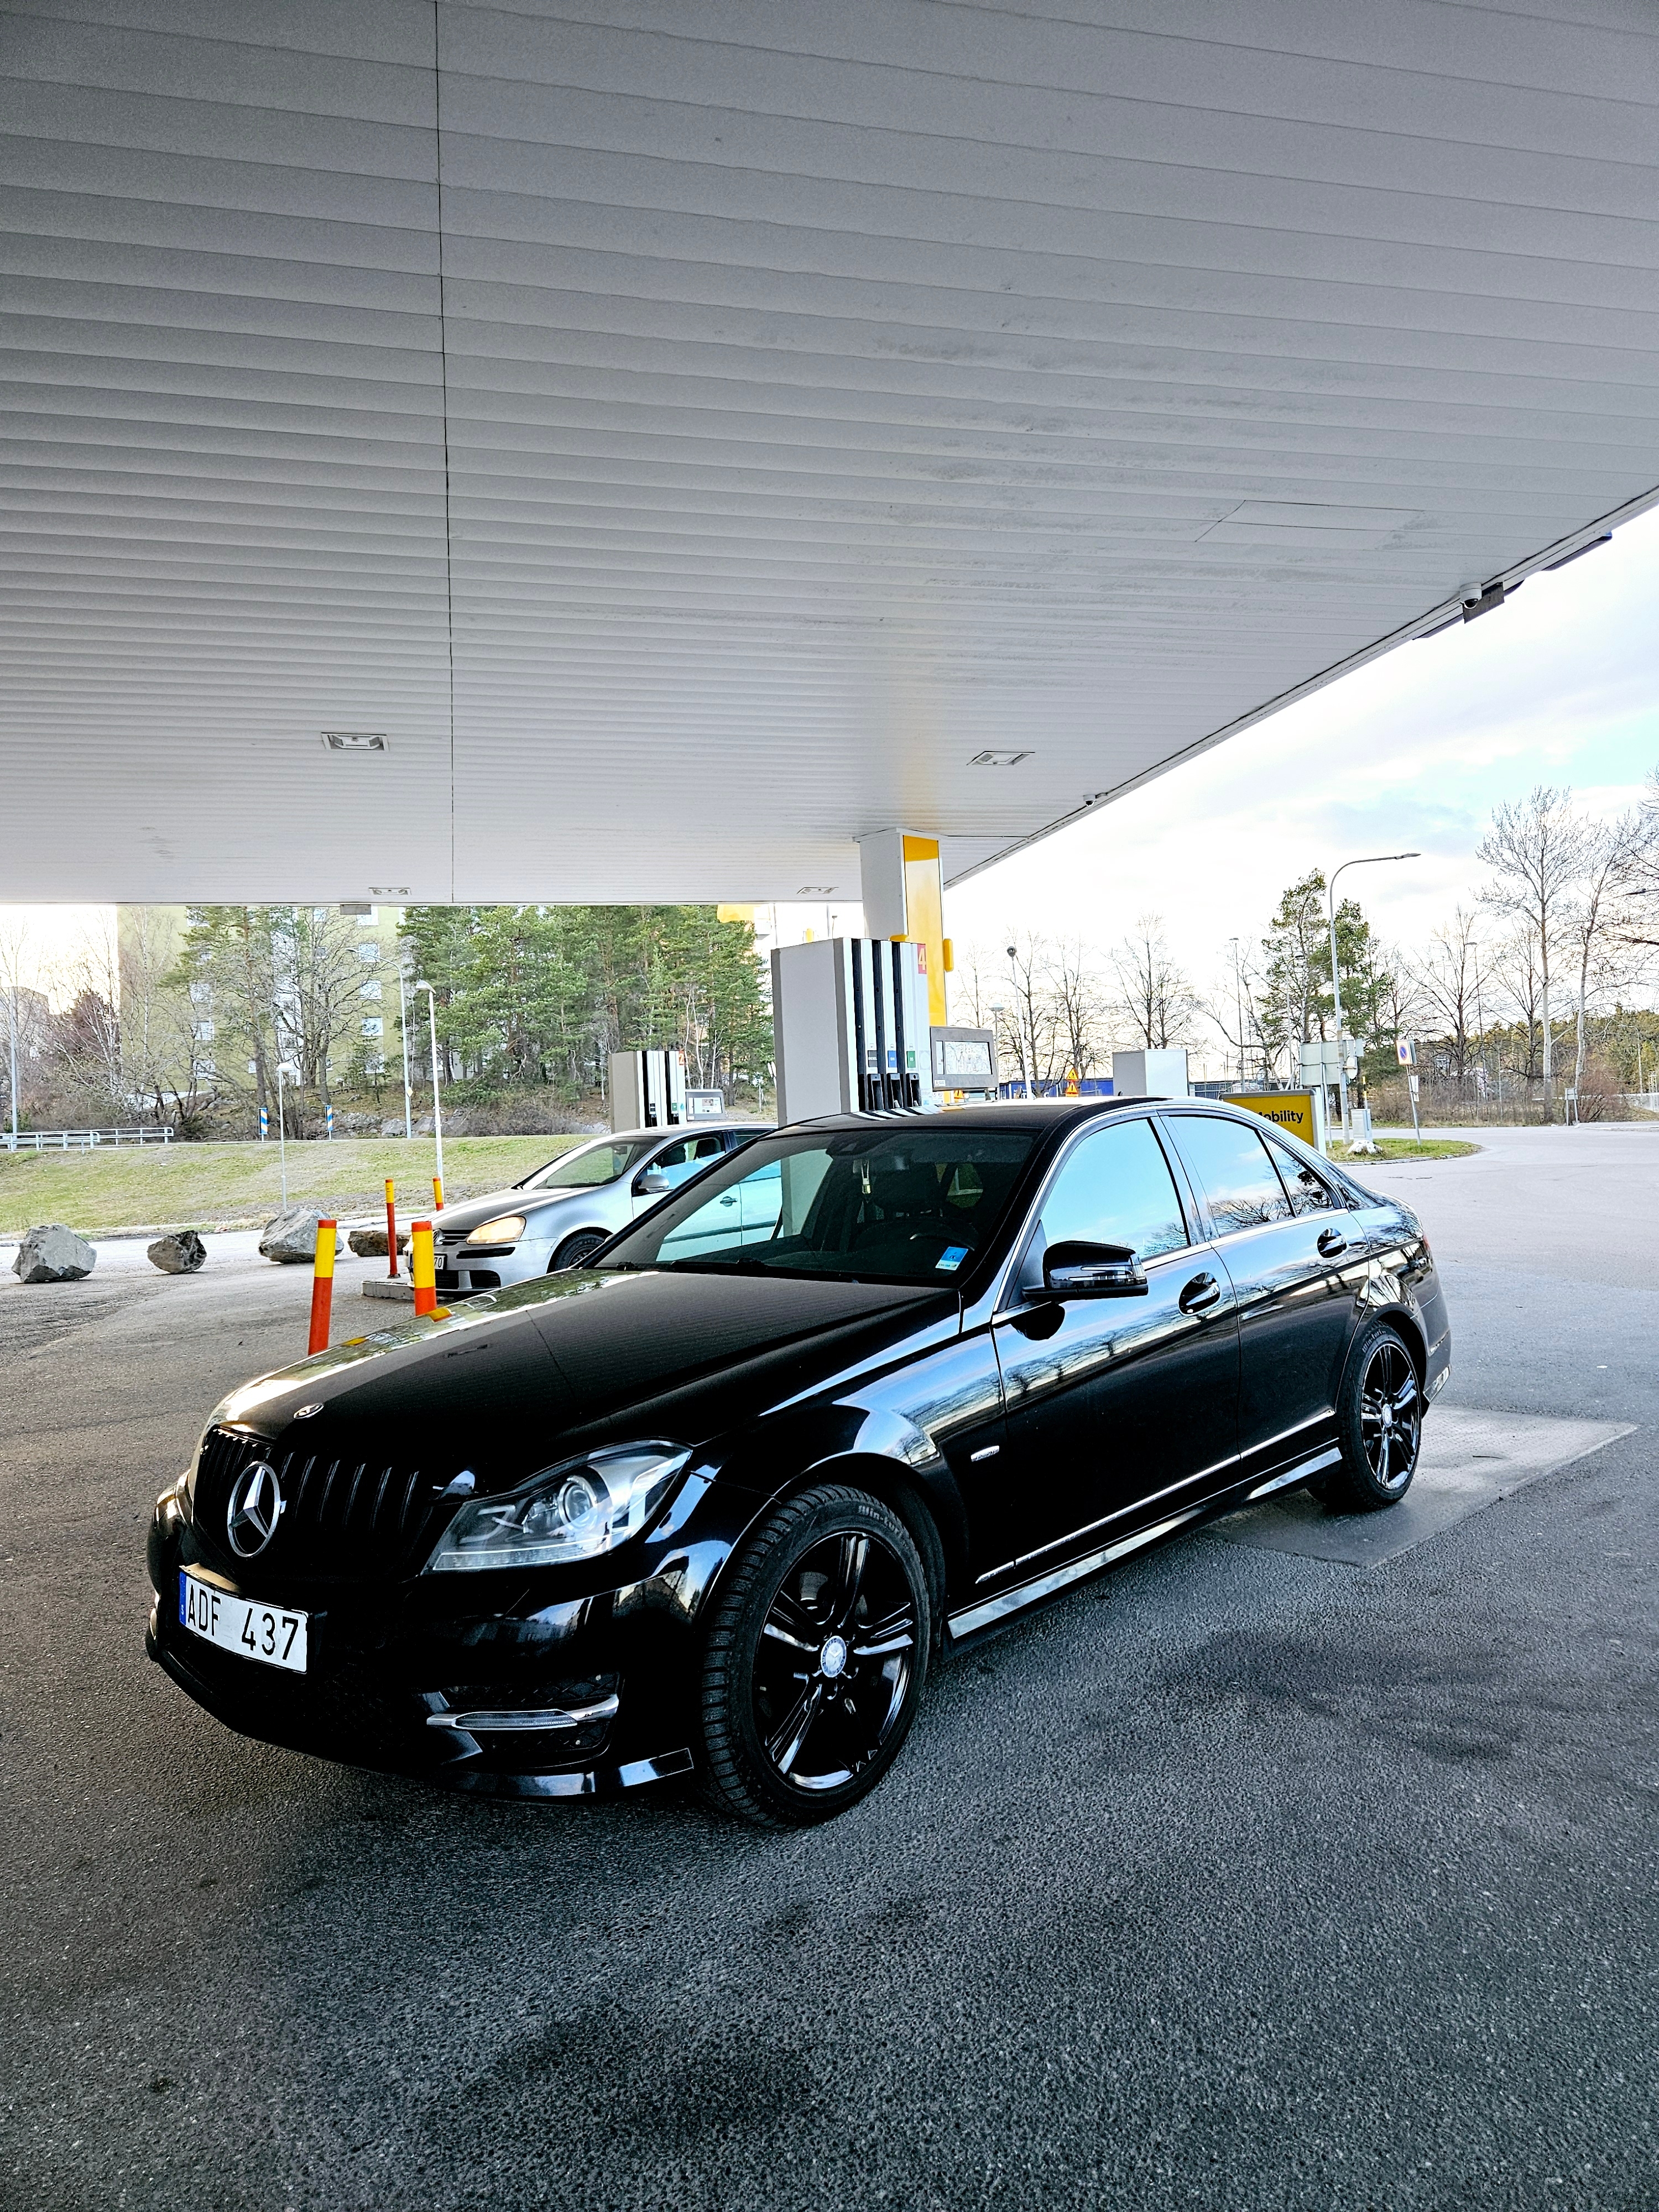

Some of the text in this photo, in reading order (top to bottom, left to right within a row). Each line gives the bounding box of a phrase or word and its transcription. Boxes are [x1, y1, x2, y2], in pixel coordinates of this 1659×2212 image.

[919, 948, 926, 971] 4
[679, 1053, 684, 1065] 2
[1258, 1110, 1303, 1124] obility
[187, 1584, 299, 1661] ADF 437
